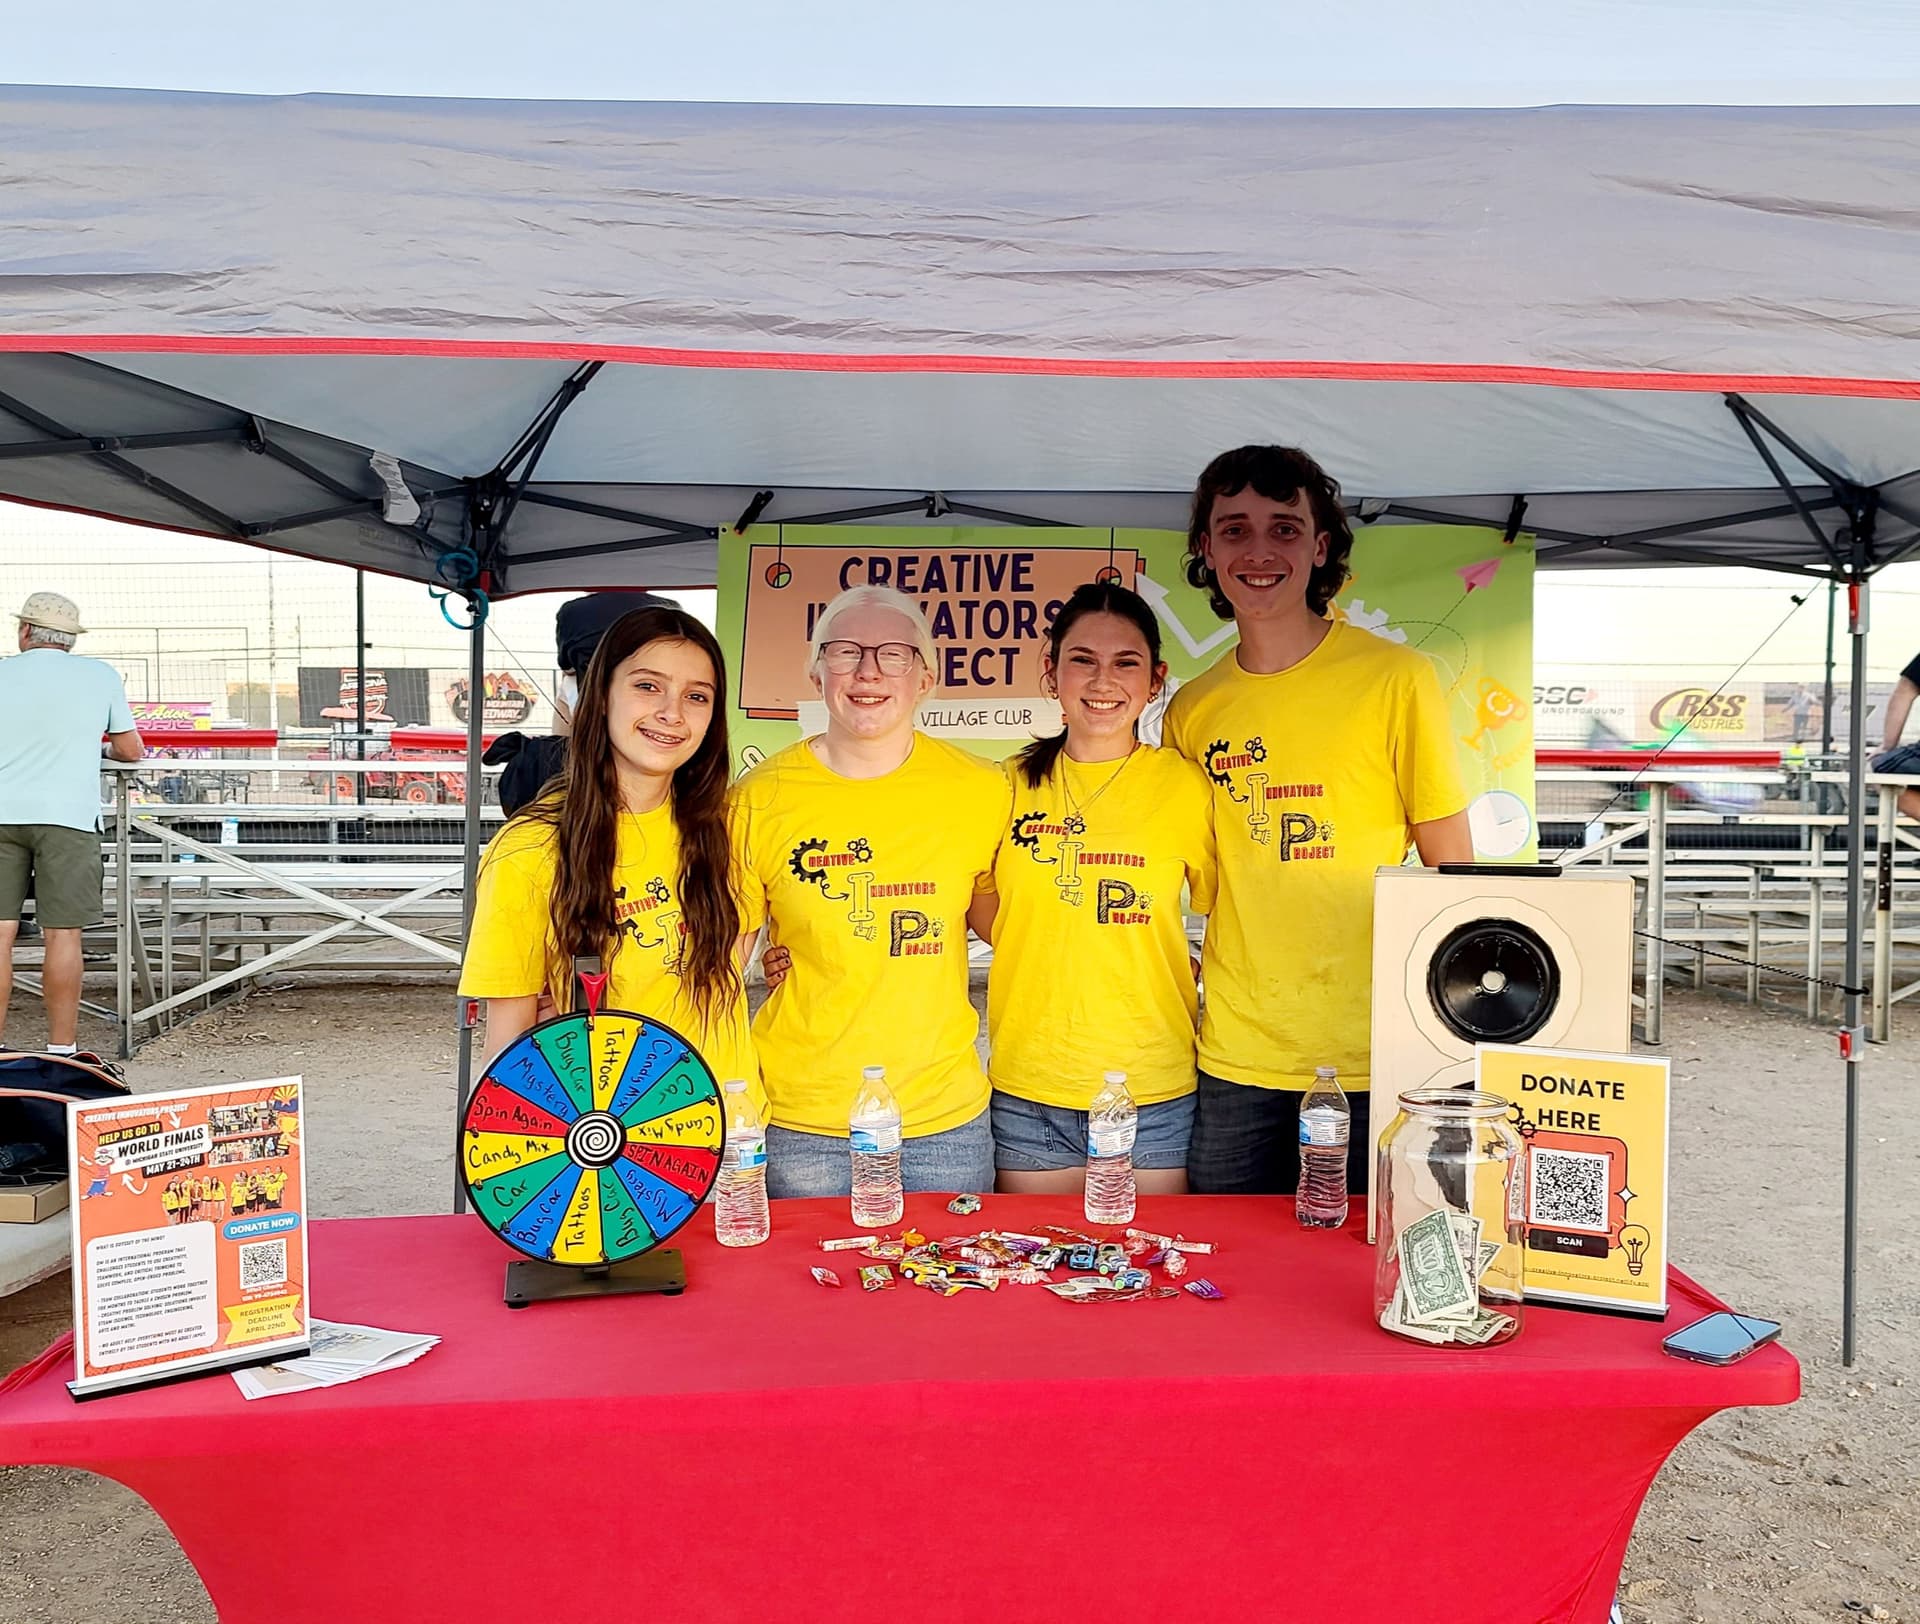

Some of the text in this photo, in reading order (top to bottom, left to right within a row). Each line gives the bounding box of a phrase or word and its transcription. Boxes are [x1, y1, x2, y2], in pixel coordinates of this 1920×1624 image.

[839, 553, 1034, 592] CREATIVE
[921, 709, 1032, 727] VILLAGE CLUB
[1542, 706, 1625, 715] UNDERGROUND
[1676, 694, 1746, 717] RSS
[1281, 813, 1335, 861] PROJECT
[1098, 879, 1151, 924] PROJECT
[890, 910, 943, 957] PROJECT
[555, 1031, 577, 1070] Bug
[598, 1028, 625, 1090] Tattoos
[631, 1039, 672, 1084] Candy
[509, 1056, 569, 1117] Mystery
[658, 1074, 694, 1105] Car
[1521, 1073, 1625, 1101] DONATE
[474, 1095, 552, 1130] Spin Again
[1538, 1108, 1601, 1131] HERE
[99, 1123, 160, 1145] HELP US GO TO
[639, 1116, 715, 1140] Candy Mix
[118, 1127, 204, 1158] WORLD FINALS
[469, 1139, 550, 1168] Candy Mix
[146, 1163, 165, 1175] MAY
[664, 1156, 709, 1183] AGAIN
[493, 1179, 528, 1207] Car
[626, 1168, 684, 1223] Mystery
[230, 1217, 294, 1235] DONATE NOW
[511, 1216, 553, 1246] Bug
[565, 1187, 591, 1251] Tattoos
[1557, 1236, 1583, 1247] SCAN
[240, 1303, 291, 1317] REGISTRATION
[248, 1313, 283, 1325] DEADLINE
[245, 1321, 286, 1334] APRIL 22ND
